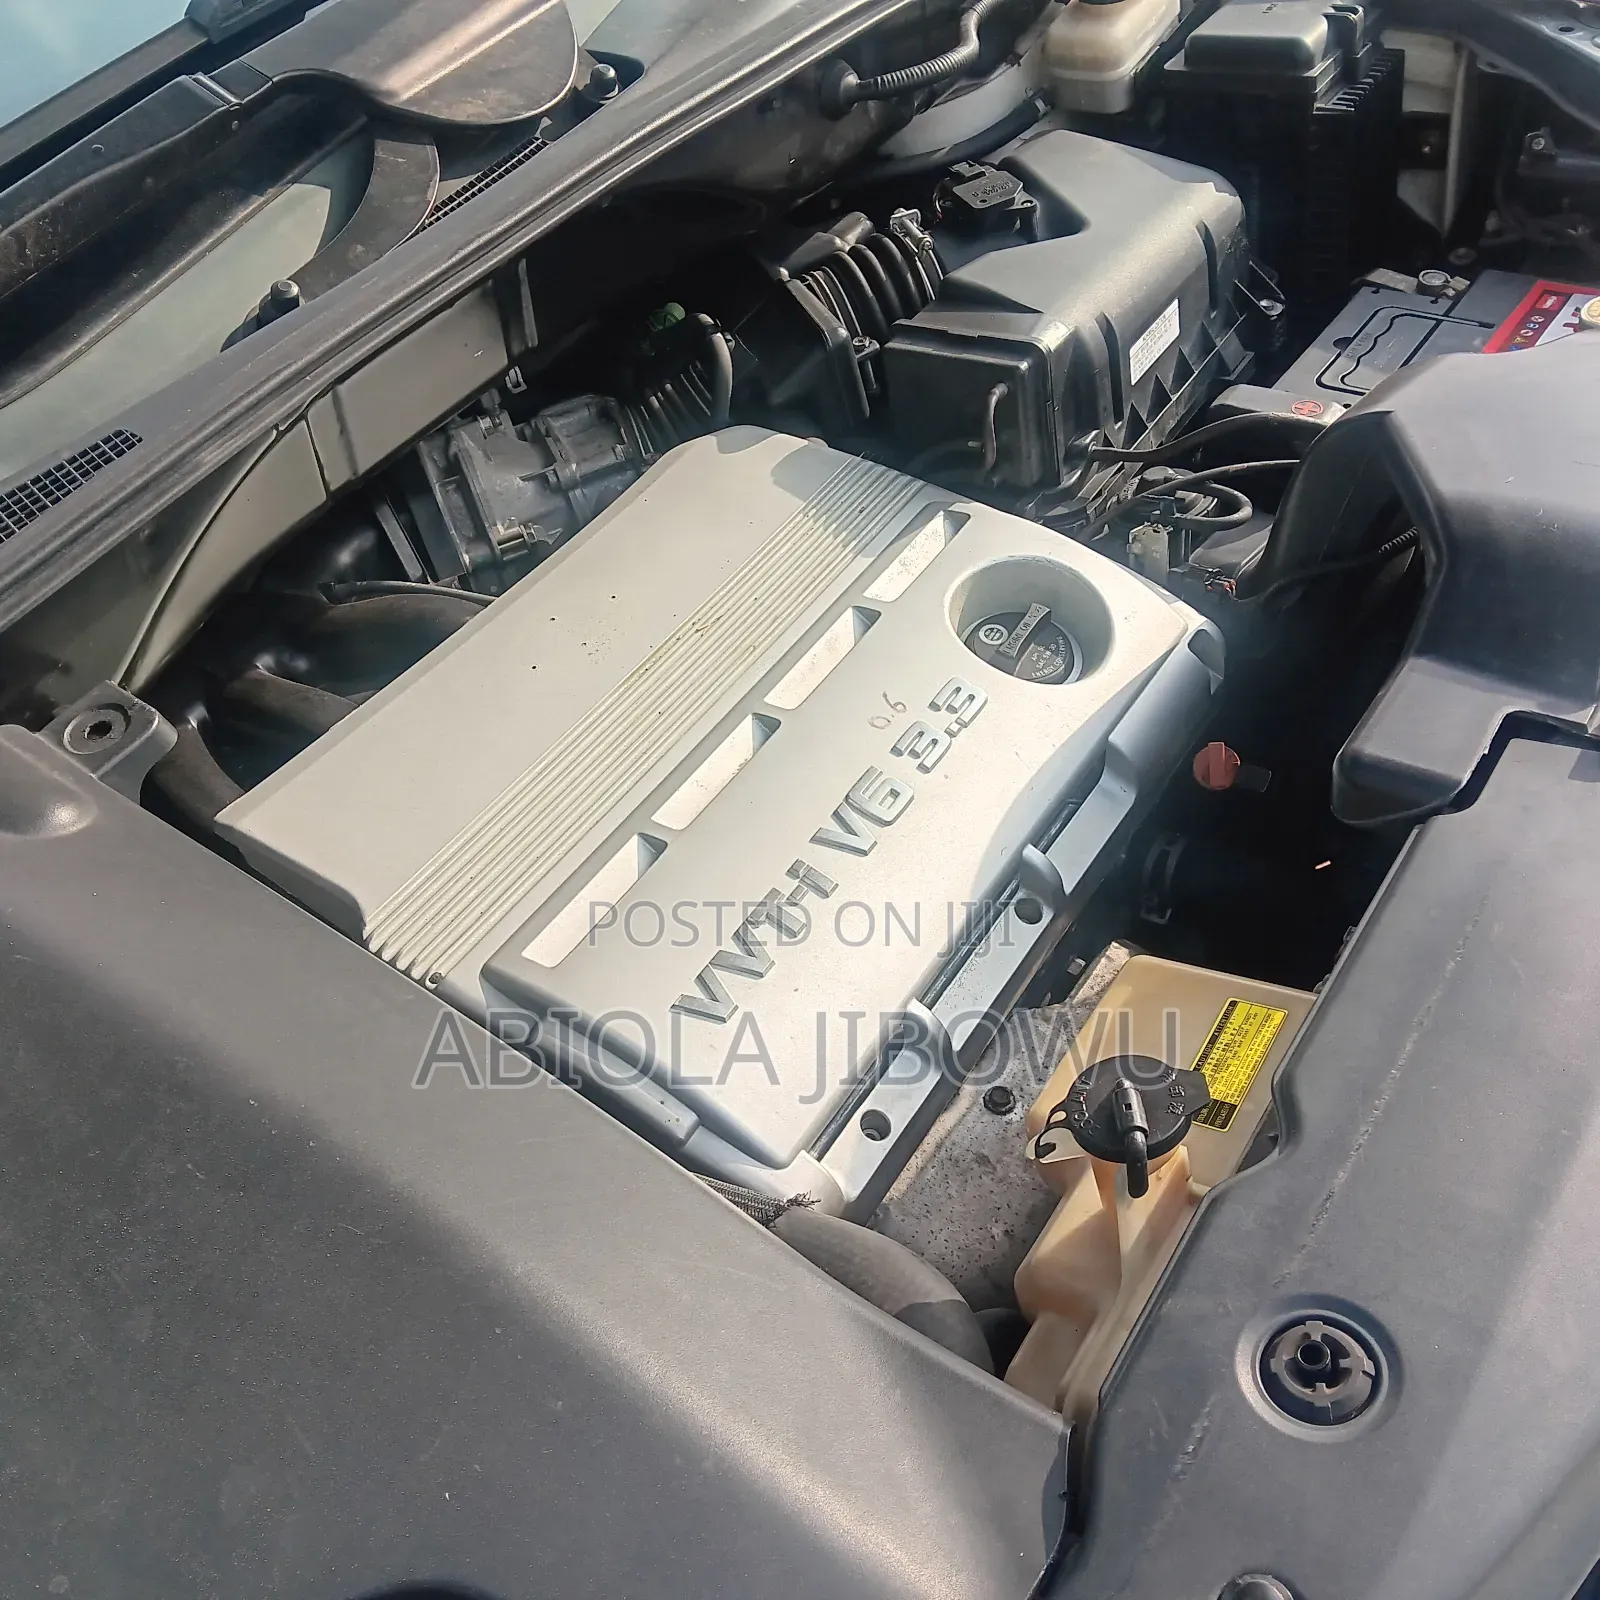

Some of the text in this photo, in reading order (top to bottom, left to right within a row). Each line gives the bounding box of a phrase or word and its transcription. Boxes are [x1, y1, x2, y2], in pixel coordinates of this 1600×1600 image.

[1032, 665, 1055, 678] ENERGY
[809, 765, 915, 857] V6
[889, 676, 988, 774] 3.3
[1195, 1005, 1234, 1069] CAUTION ATTENTION
